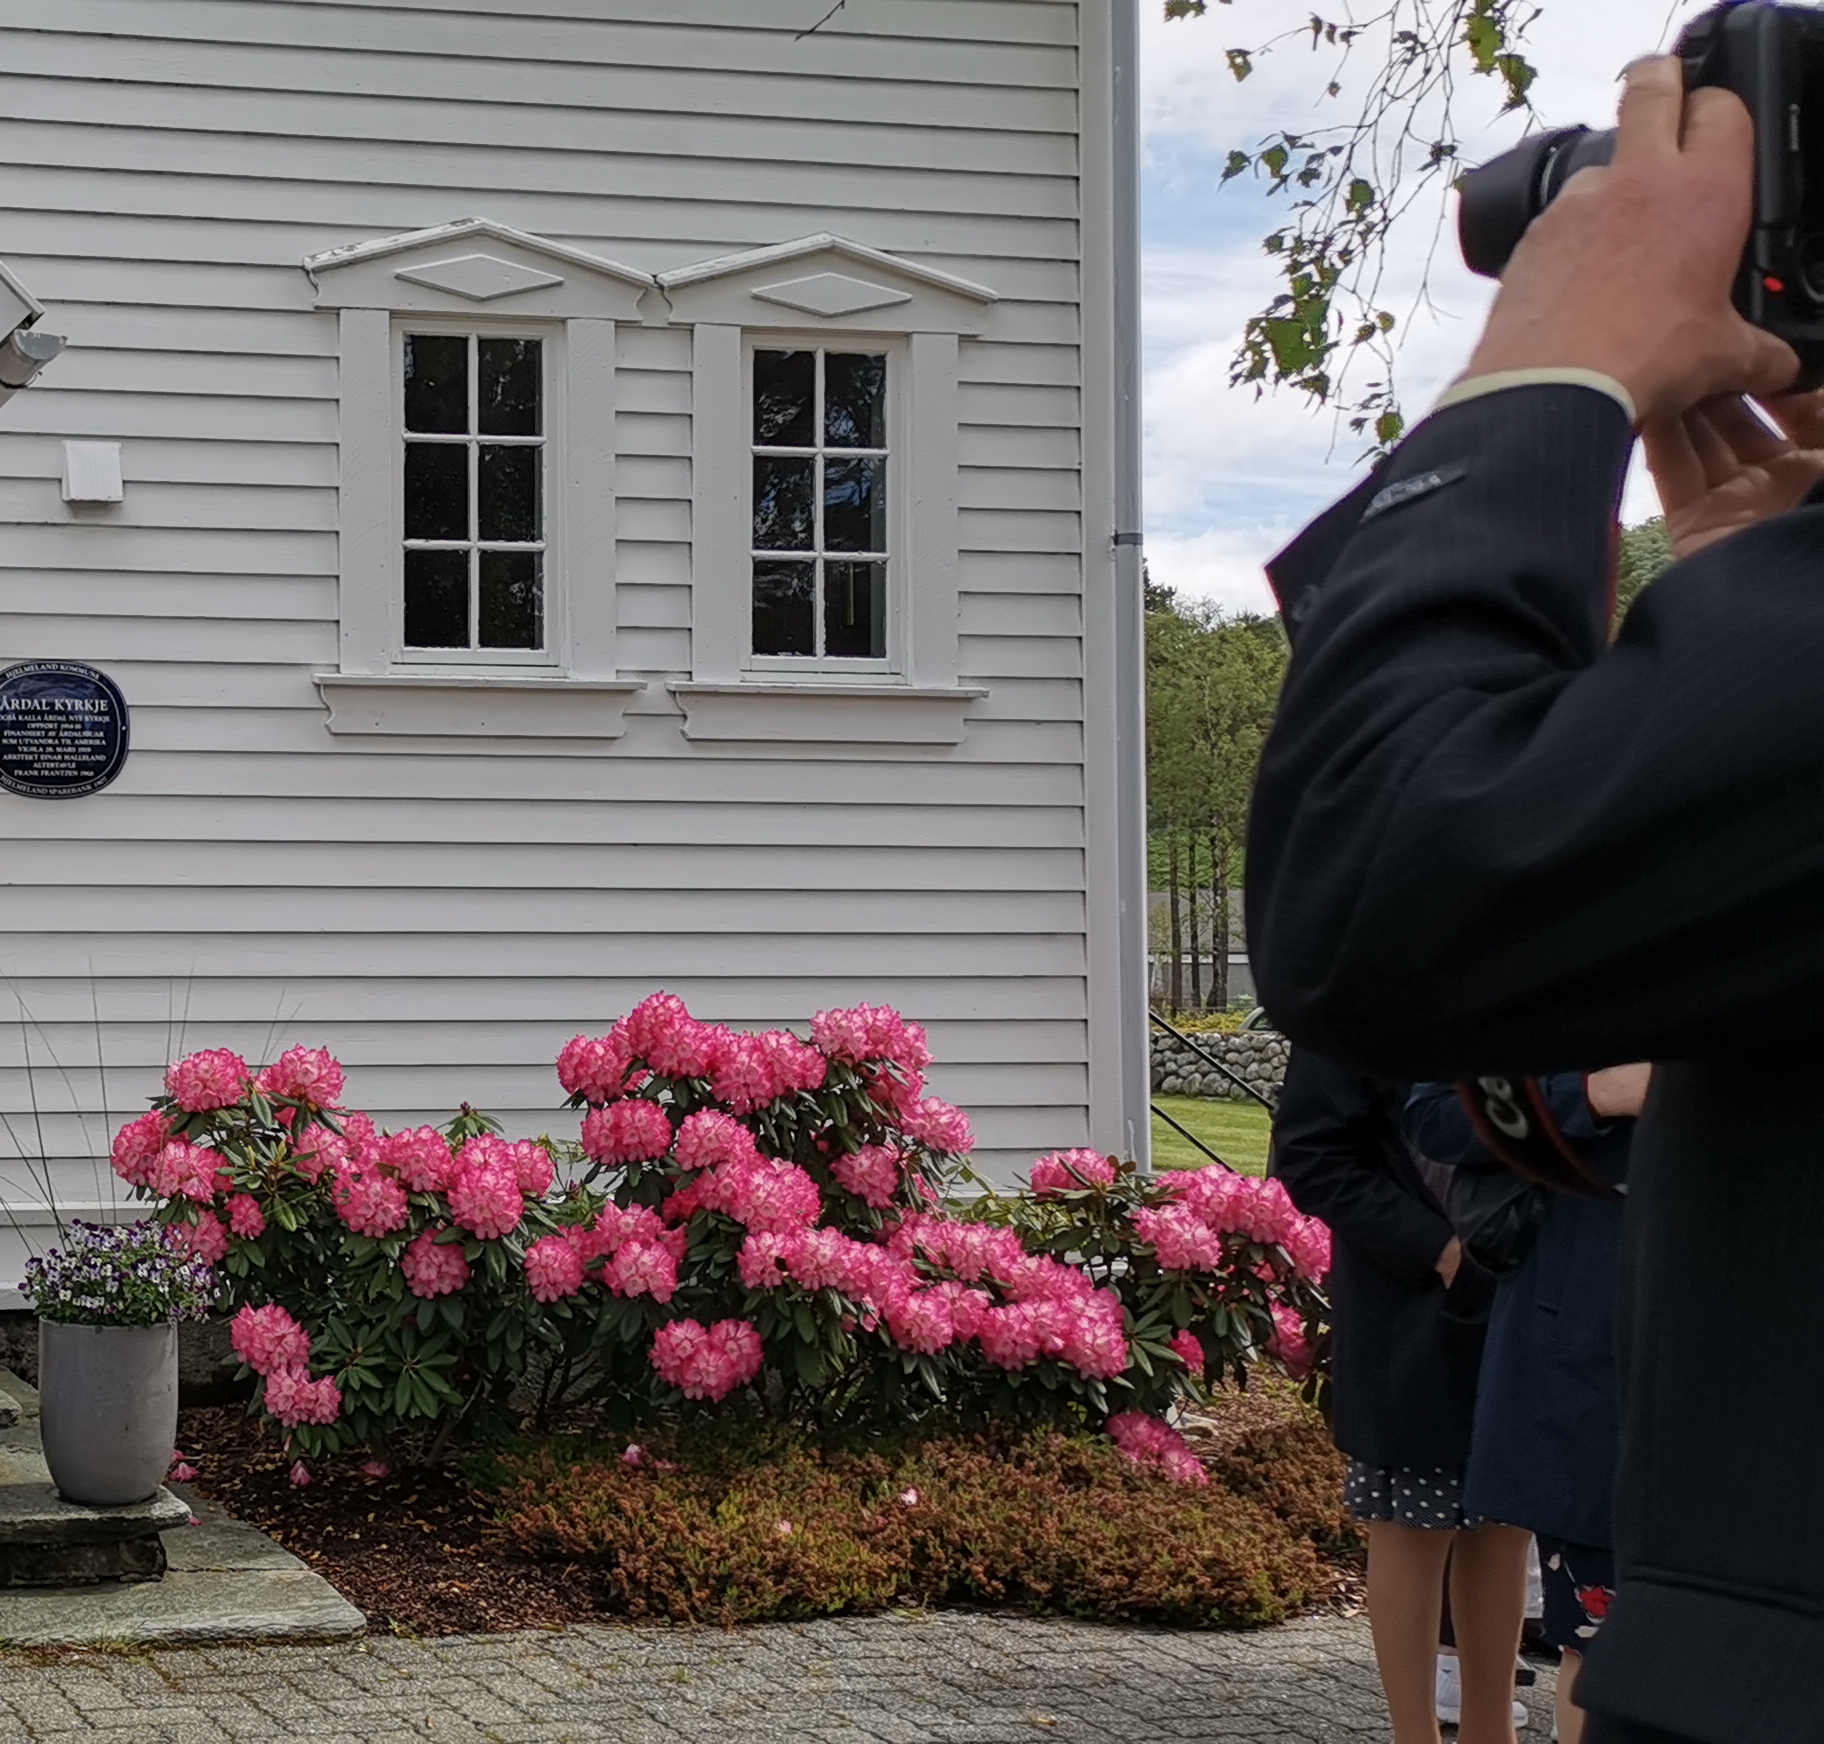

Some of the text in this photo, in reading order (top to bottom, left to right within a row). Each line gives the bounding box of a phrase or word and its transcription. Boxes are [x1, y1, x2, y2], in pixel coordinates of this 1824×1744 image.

[6, 664, 100, 679] HJELMELAND KOMMUNE
[0, 695, 109, 712] ÅRDAL KYRKJE
[43, 714, 67, 722] ÅRDAL
[85, 715, 110, 723] KYRKJE
[0, 775, 48, 794] HJELMELAND
[49, 785, 92, 795] SPAREBANK
